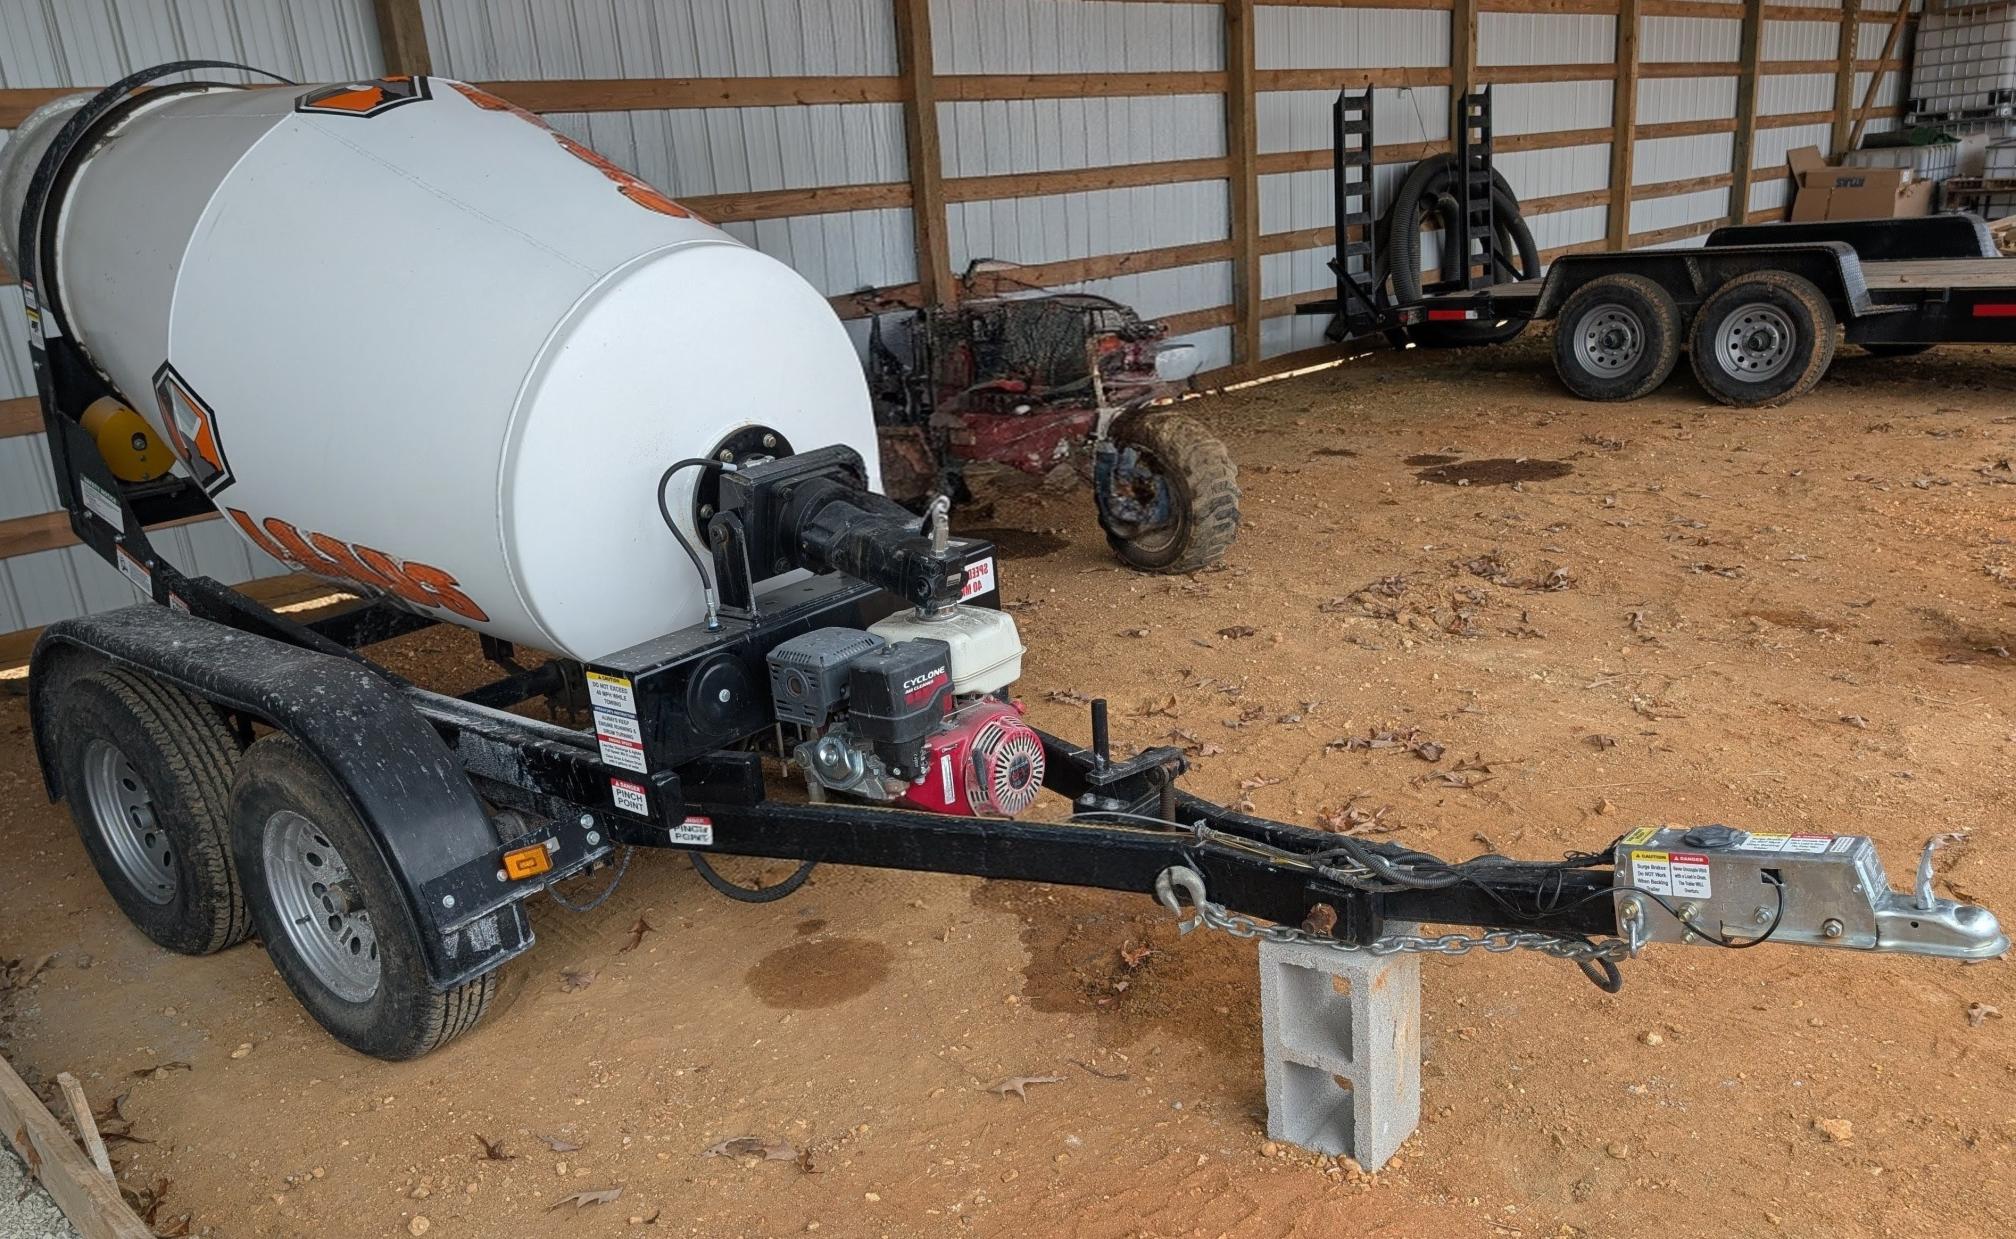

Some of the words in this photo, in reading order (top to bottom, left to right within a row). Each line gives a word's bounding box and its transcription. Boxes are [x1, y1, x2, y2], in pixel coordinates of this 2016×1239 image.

[903, 665, 946, 689] CYCLONE
[621, 781, 640, 792] DANGER
[616, 788, 643, 803] PINCH
[618, 797, 643, 811] POINT
[1636, 863, 1650, 871] Surge
